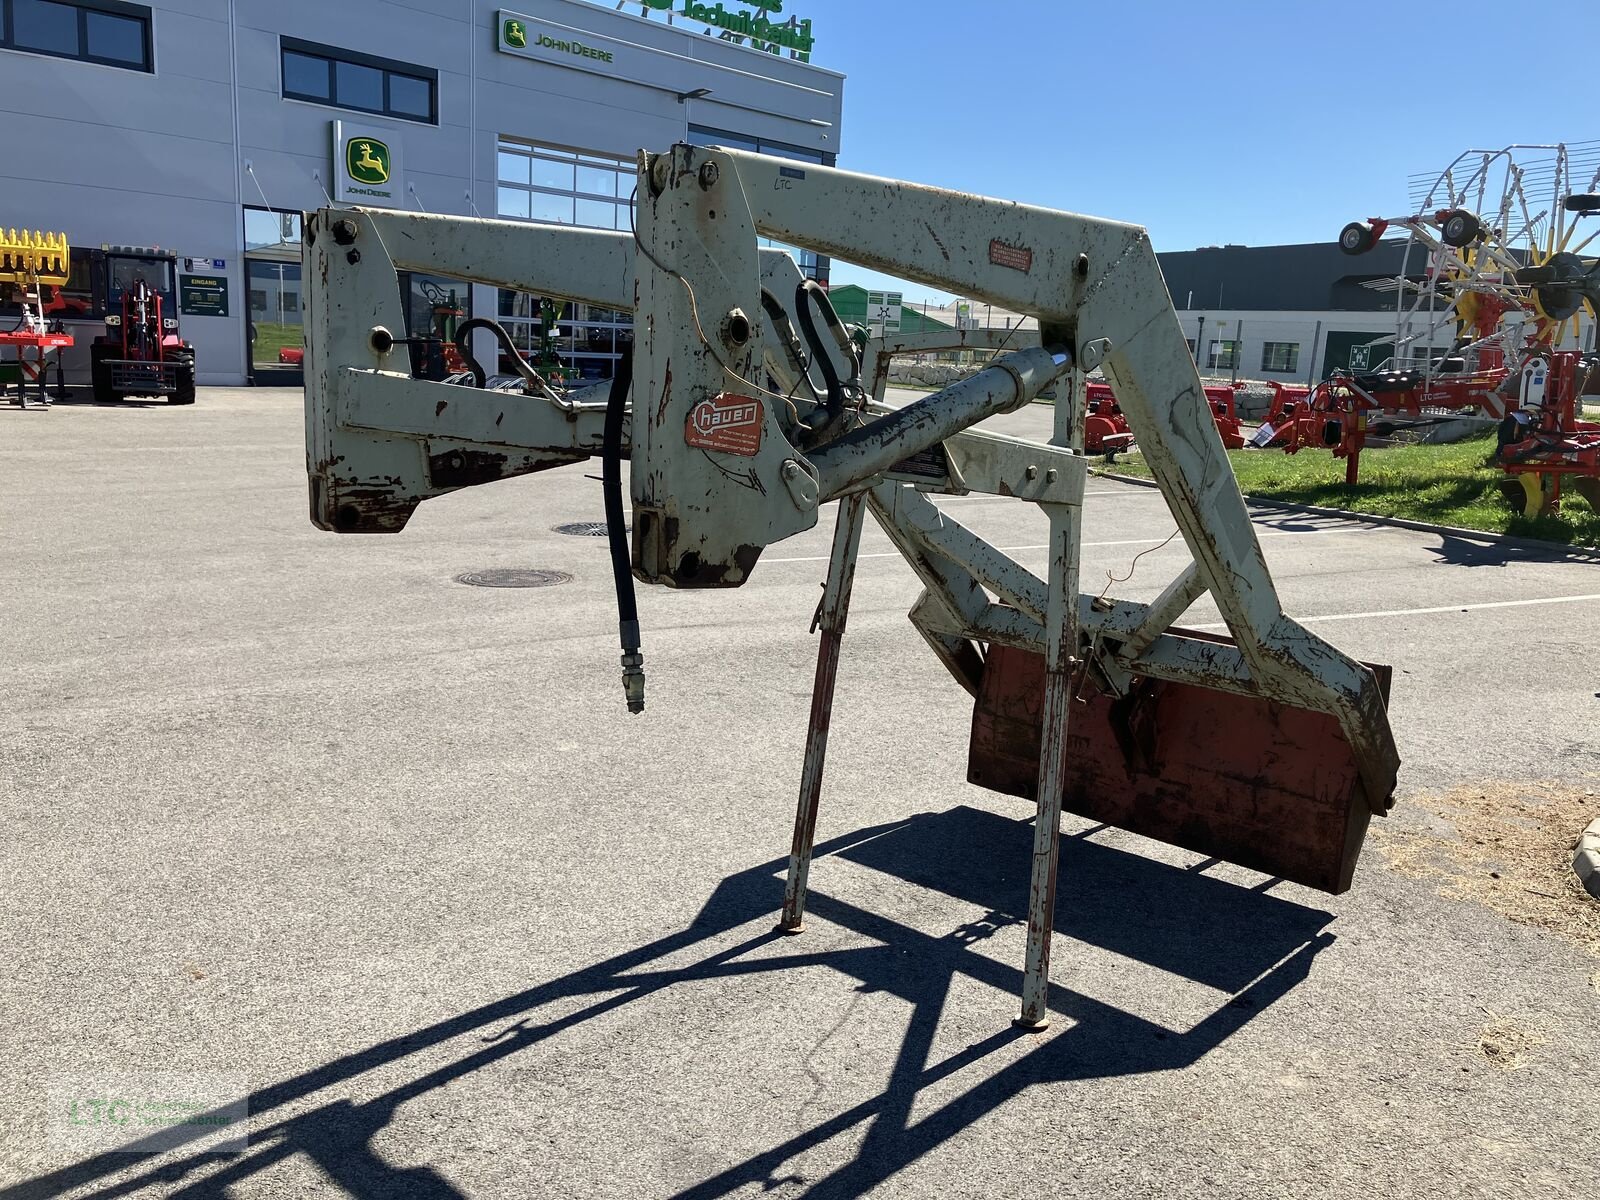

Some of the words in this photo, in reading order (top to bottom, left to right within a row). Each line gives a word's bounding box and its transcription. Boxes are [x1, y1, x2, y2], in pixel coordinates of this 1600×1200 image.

[535, 33, 570, 53] JOHN
[572, 42, 613, 63] DEERE
[774, 178, 793, 190] LTC
[346, 186, 366, 195] JOHN
[367, 188, 392, 198] DEERE
[191, 278, 217, 286] EINGANG
[1420, 393, 1433, 402] LTC
[700, 406, 754, 427] hauer
